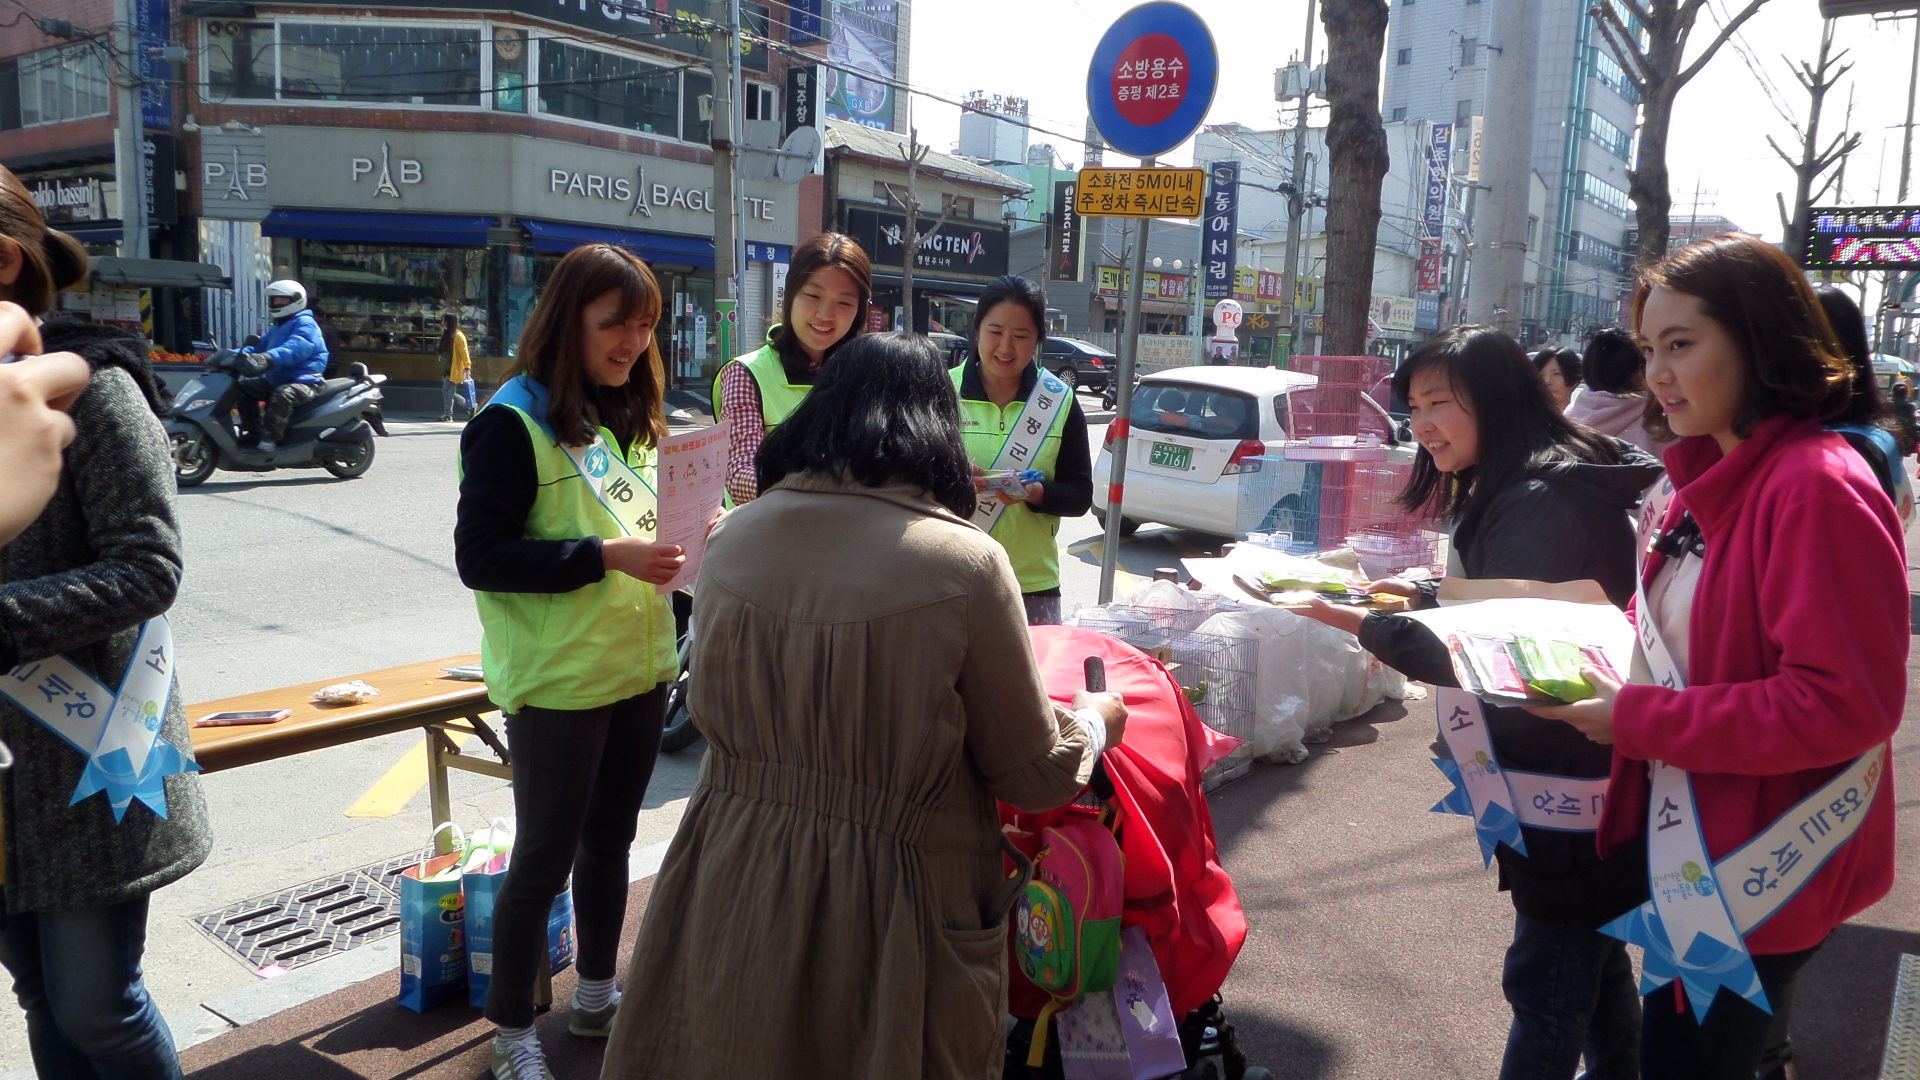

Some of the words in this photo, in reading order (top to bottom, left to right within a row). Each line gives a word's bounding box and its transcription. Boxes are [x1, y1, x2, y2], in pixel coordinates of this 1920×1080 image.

[1117, 57, 1184, 80] 소방용수
[1117, 85, 1142, 101] 증평
[1145, 83, 1180, 99] 제2호
[57, 176, 93, 206] bassini
[551, 169, 632, 201] PARIS
[1088, 172, 1132, 190] 소화전
[1136, 173, 1194, 191] 5M이내
[1063, 196, 1073, 229] HANG
[1133, 193, 1197, 213] 즉시단속
[912, 231, 943, 252] ANG
[946, 236, 971, 255] TEN
[1062, 231, 1072, 253] TEN
[1210, 191, 1231, 280] 동아서림
[1221, 311, 1242, 325] PC
[1162, 452, 1186, 468] 7161
[145, 645, 168, 675] 소
[38, 672, 96, 719] 세상
[1449, 705, 1474, 732] 소
[1532, 789, 1582, 816] 세상
[1656, 796, 1682, 832] 소
[1799, 787, 1862, 844] 없는
[1743, 841, 1803, 897] 세상
